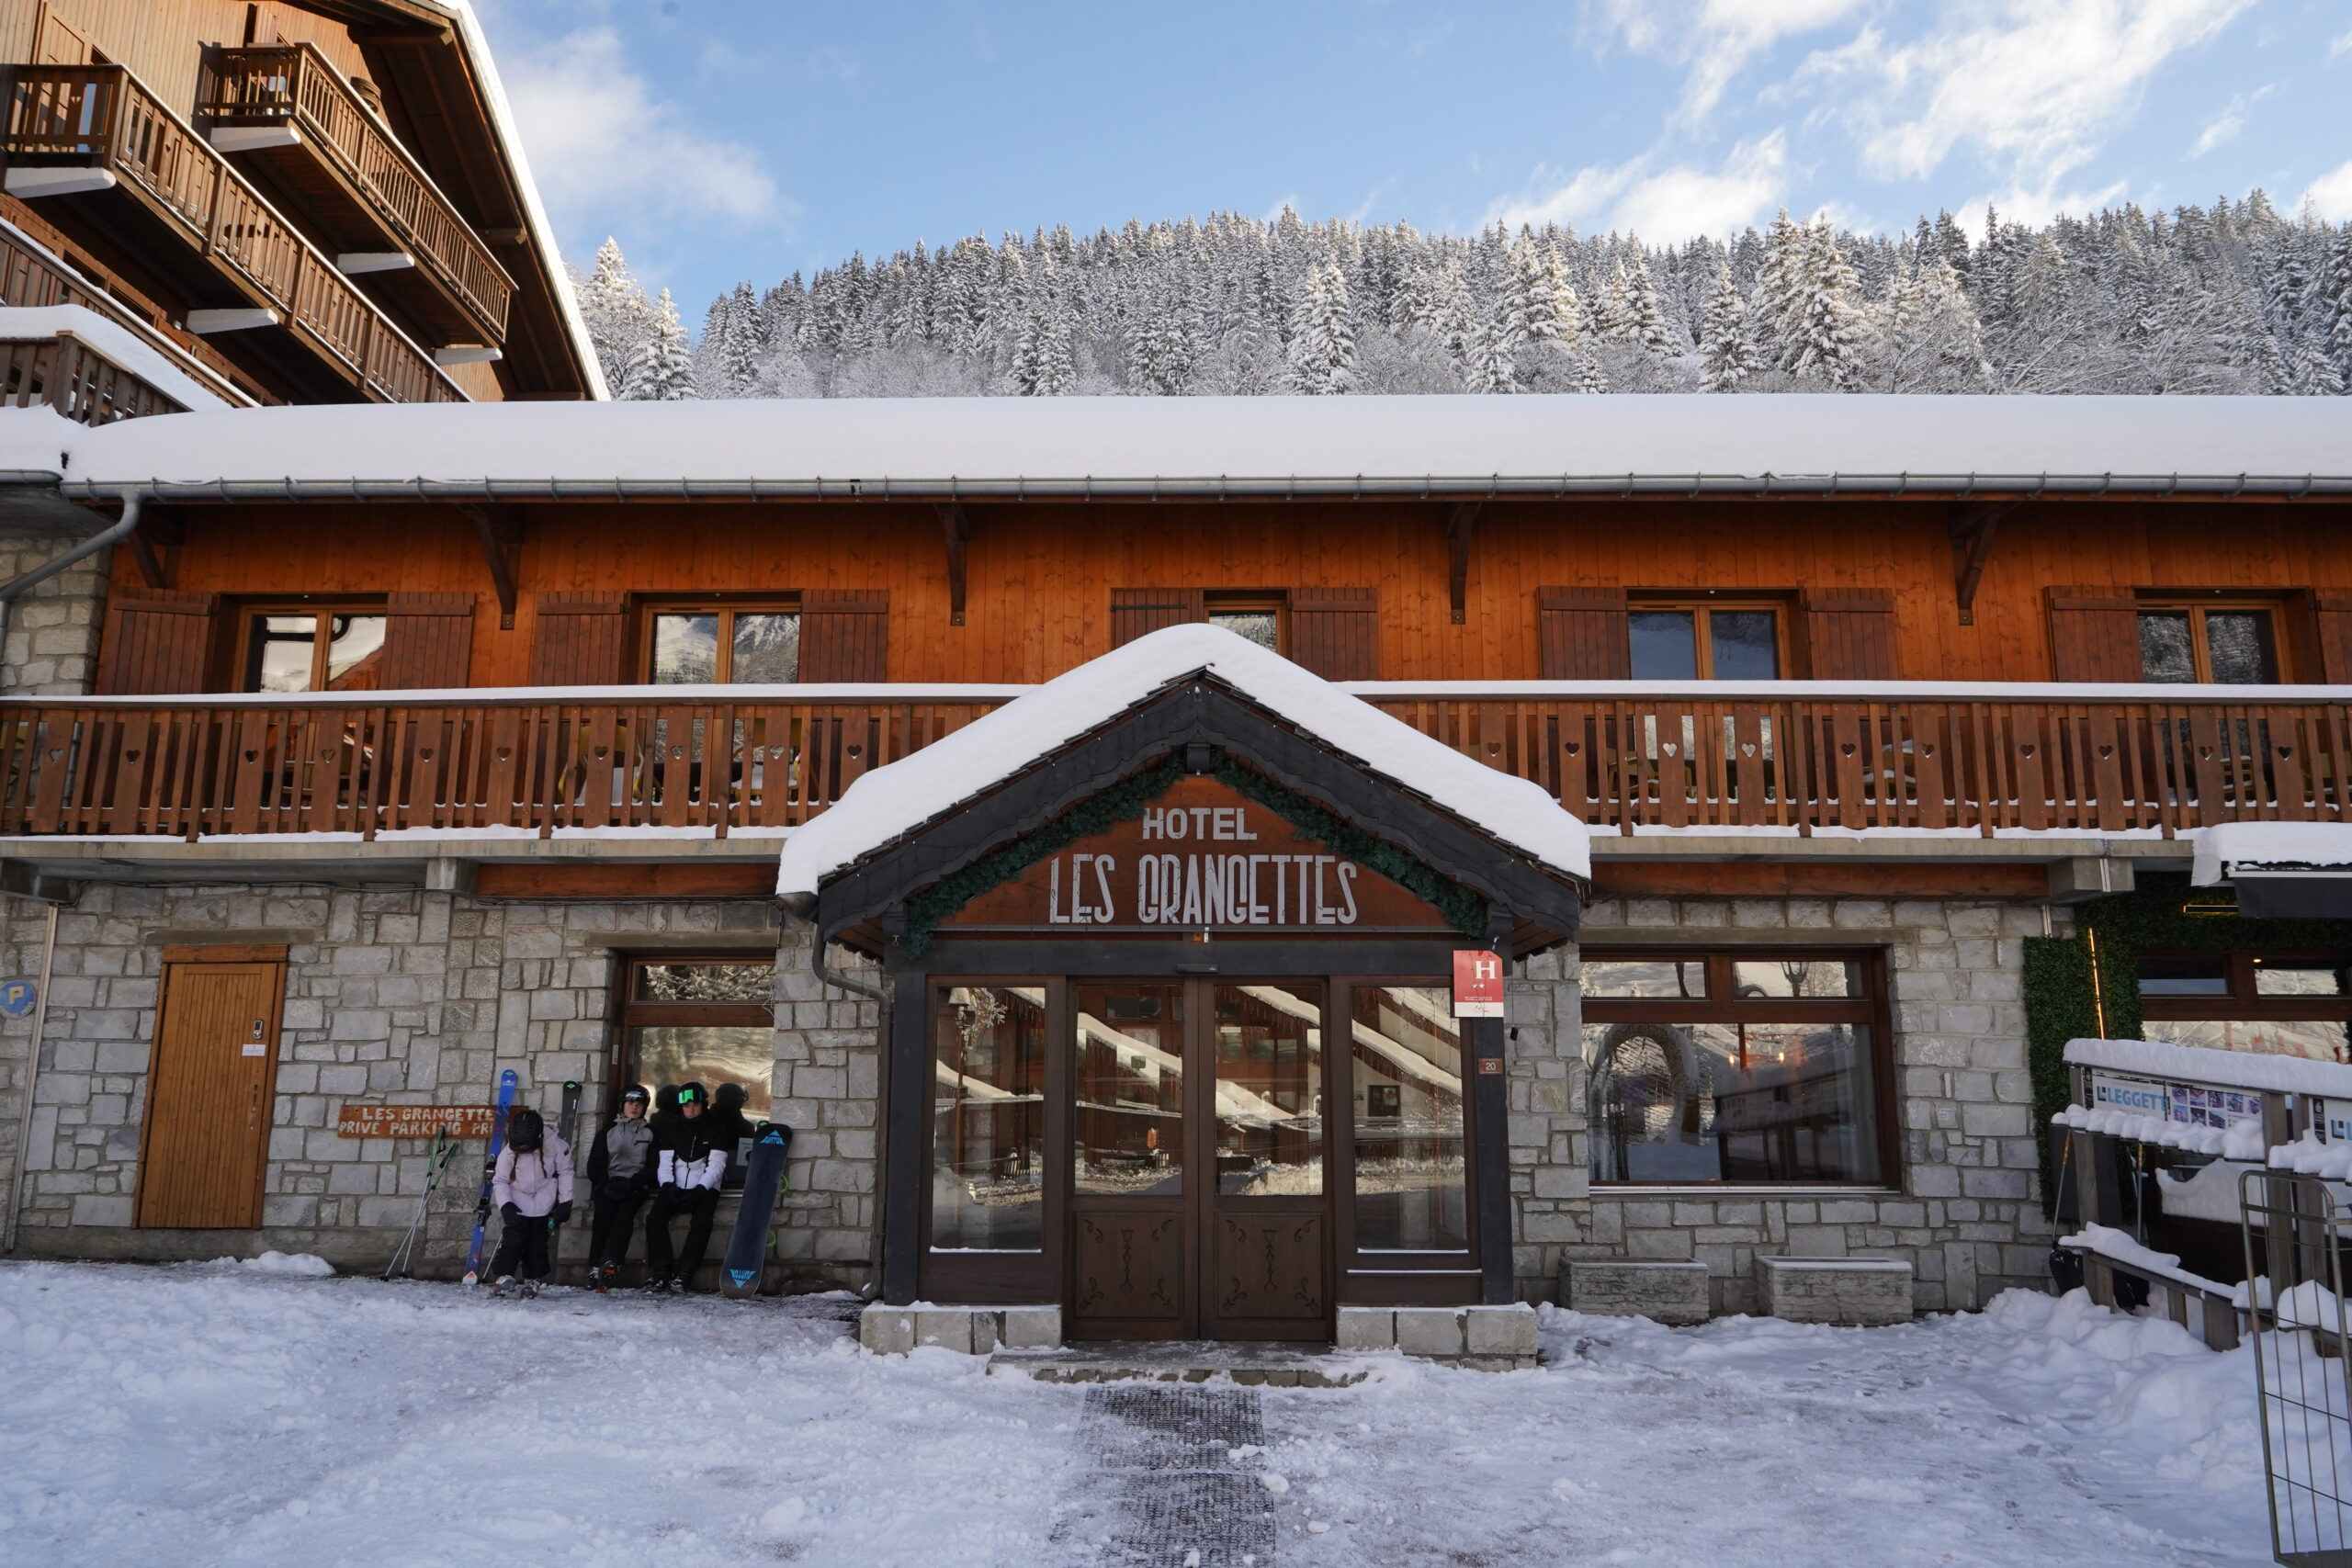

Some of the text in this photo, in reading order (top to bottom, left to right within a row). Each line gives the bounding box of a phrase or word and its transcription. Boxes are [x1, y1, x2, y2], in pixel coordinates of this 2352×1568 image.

[1142, 807, 1257, 840] HOTEL
[1049, 853, 1357, 925] LES GRANGETTES
[1475, 960, 1497, 979] H
[9, 986, 24, 1005] P
[1486, 1062, 1496, 1071] 20
[362, 1108, 494, 1122] LES GRANGETTE
[390, 1121, 461, 1135] PARKING
